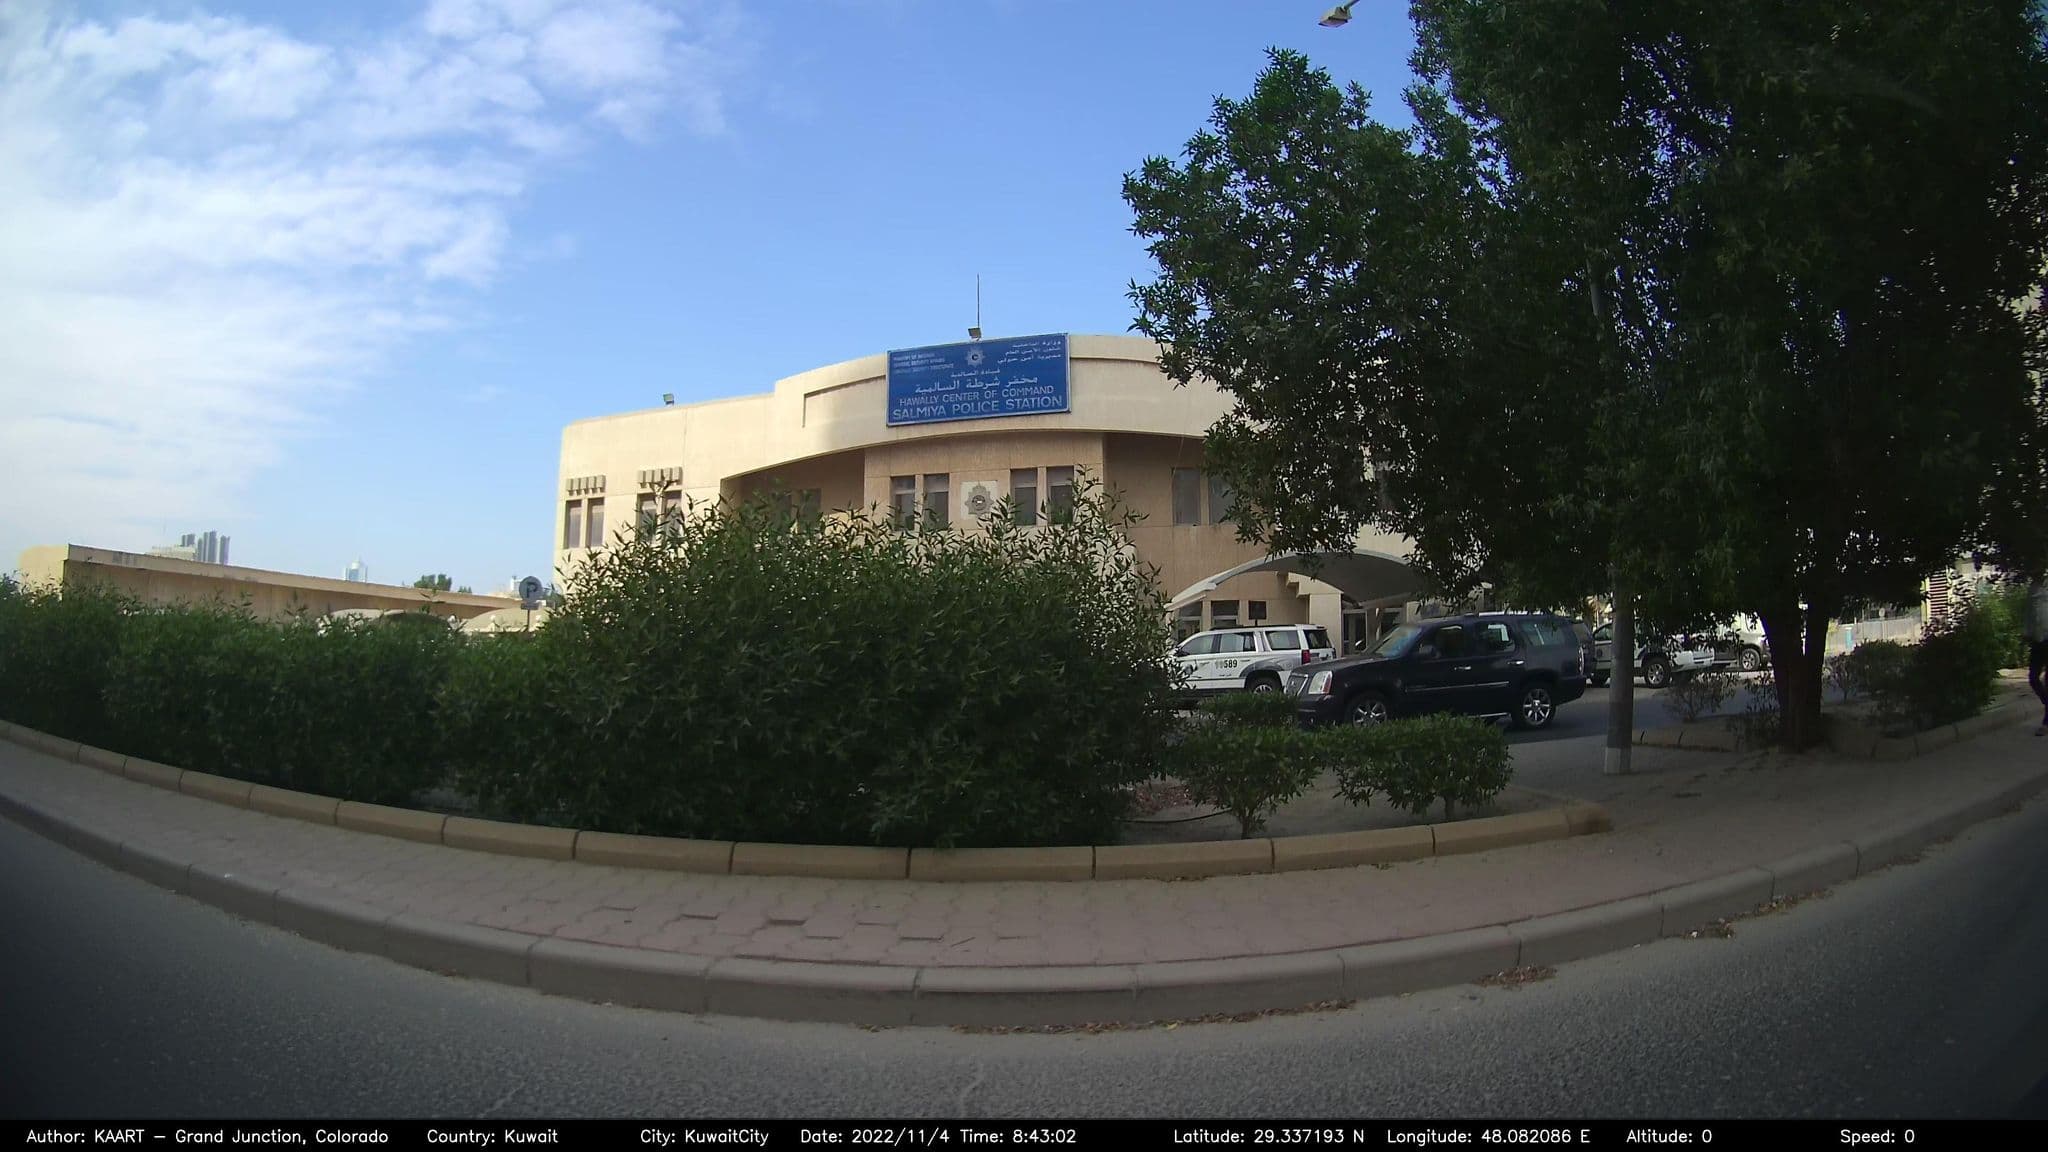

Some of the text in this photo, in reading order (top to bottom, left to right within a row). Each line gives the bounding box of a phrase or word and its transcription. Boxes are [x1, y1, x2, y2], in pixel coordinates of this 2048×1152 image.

[915, 375, 1038, 394] مخفر شرطة السالمية
[900, 385, 1054, 407] HAWALLY CENTER OF COMMAND
[892, 395, 1063, 420] SALMIYA POLICE STATION
